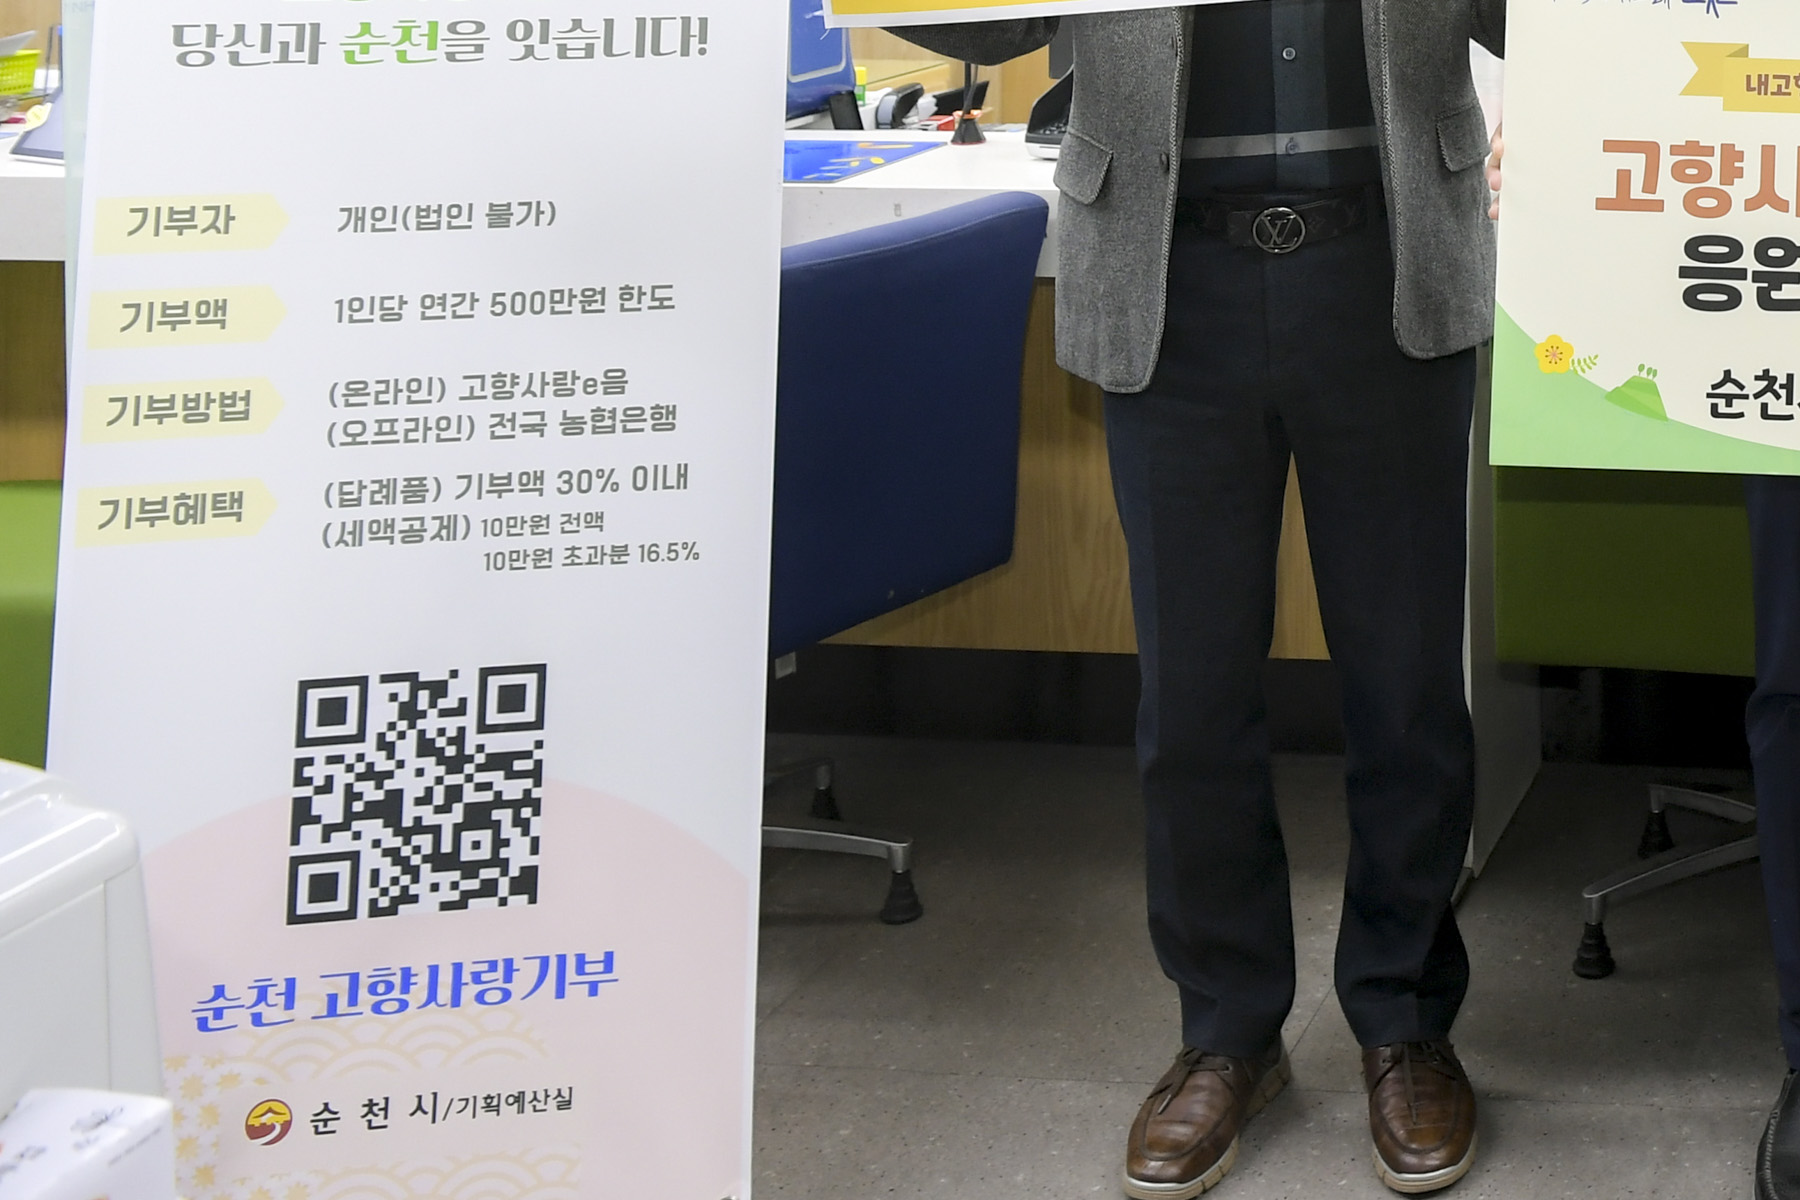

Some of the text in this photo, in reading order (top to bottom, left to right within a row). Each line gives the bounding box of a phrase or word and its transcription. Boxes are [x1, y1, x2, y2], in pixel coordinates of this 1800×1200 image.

[171, 17, 709, 67] 당신과 순천을 잇습니다!
[126, 205, 236, 238] 기부자
[337, 201, 557, 234] 개인(법인 불가)
[120, 298, 228, 333] 기부액
[334, 284, 676, 324] 1인당 연간 500만원 한도
[328, 368, 629, 409] (온라인) 고향사랑e음
[106, 390, 252, 428] 기부방법
[326, 404, 678, 449] (오프라인) 전국 농협은행
[323, 463, 688, 509] (답례품) 기부액 30% 이내
[97, 490, 244, 532] 기부혜택
[322, 512, 604, 549] (세액공제) 10만원 전액
[483, 541, 700, 573] 10만원 초과분 16.5%
[191, 951, 619, 1033] 순천 고향사랑기부
